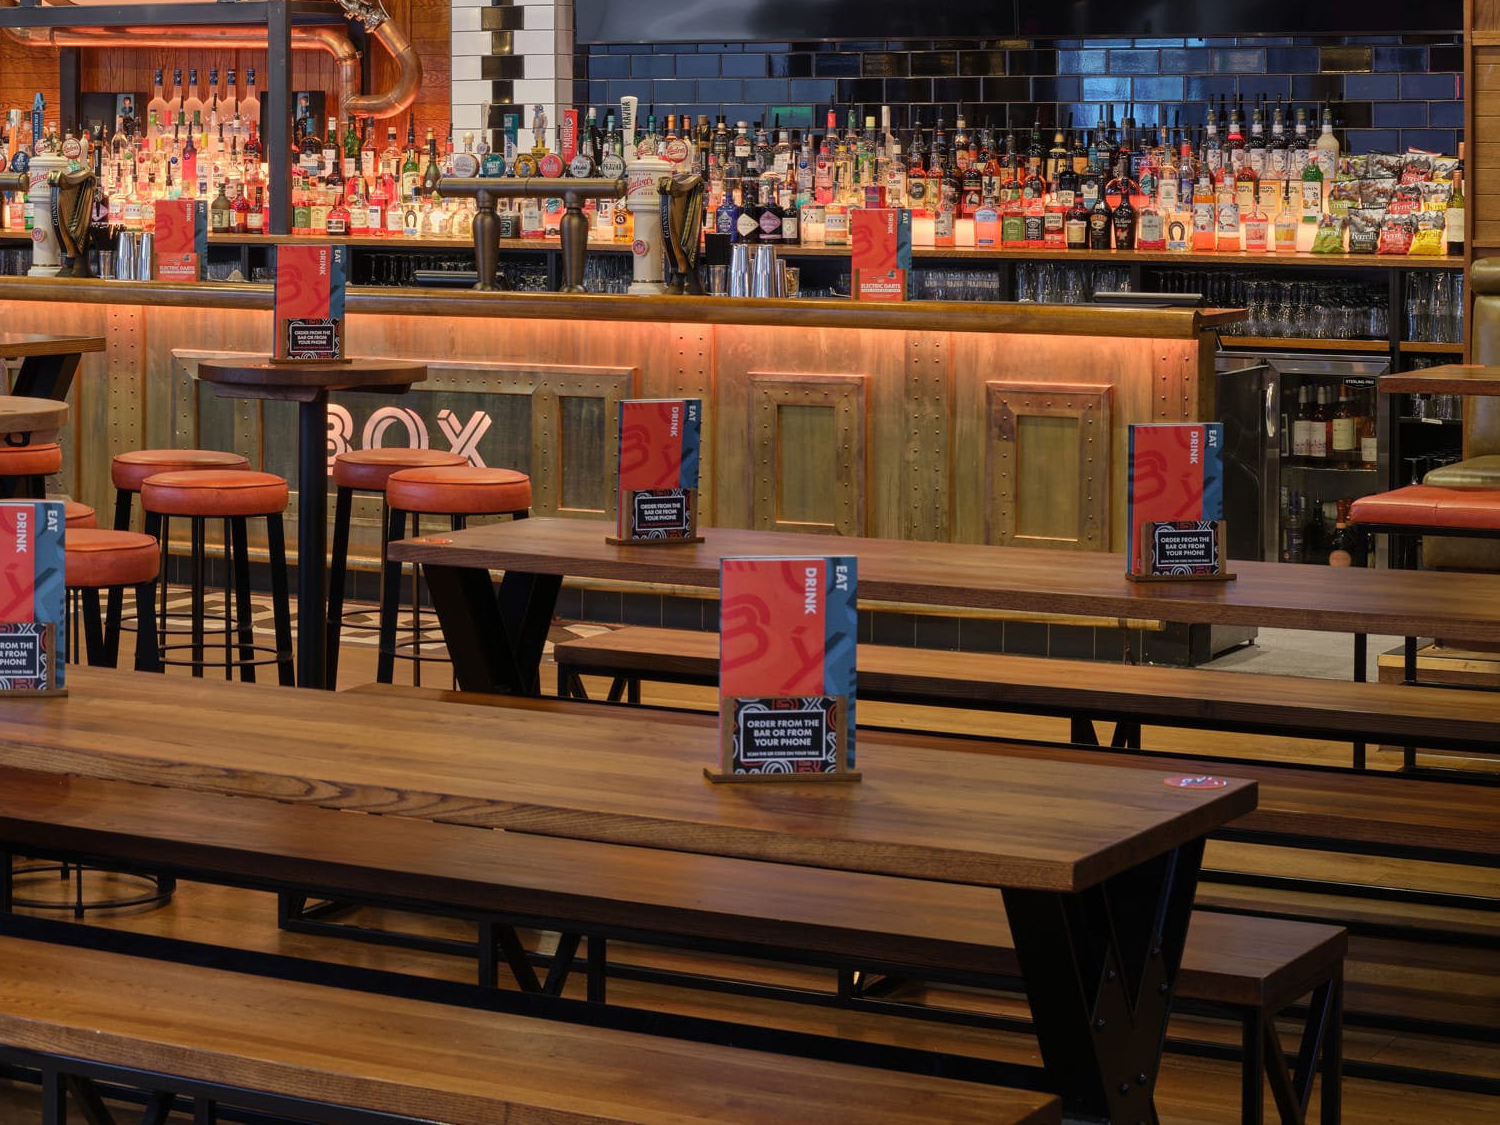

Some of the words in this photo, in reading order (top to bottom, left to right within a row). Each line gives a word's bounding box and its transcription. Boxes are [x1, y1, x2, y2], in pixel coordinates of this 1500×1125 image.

[622, 101, 631, 130] PRAVHA
[662, 205, 670, 238] GUINNESS
[670, 406, 679, 437] DRINK
[688, 405, 696, 422] EAT
[1190, 431, 1198, 464] DRINK
[1209, 430, 1217, 447] EAT
[16, 512, 27, 553] DRINK
[47, 510, 58, 532] EAT
[804, 567, 817, 615] DRINK
[836, 565, 848, 591] EAT
[747, 720, 776, 728] ORDER
[804, 719, 820, 727] THE
[753, 729, 771, 737] BAR
[772, 729, 786, 737] OR
[754, 738, 779, 746] YOUR
[781, 738, 812, 746] PHONE
